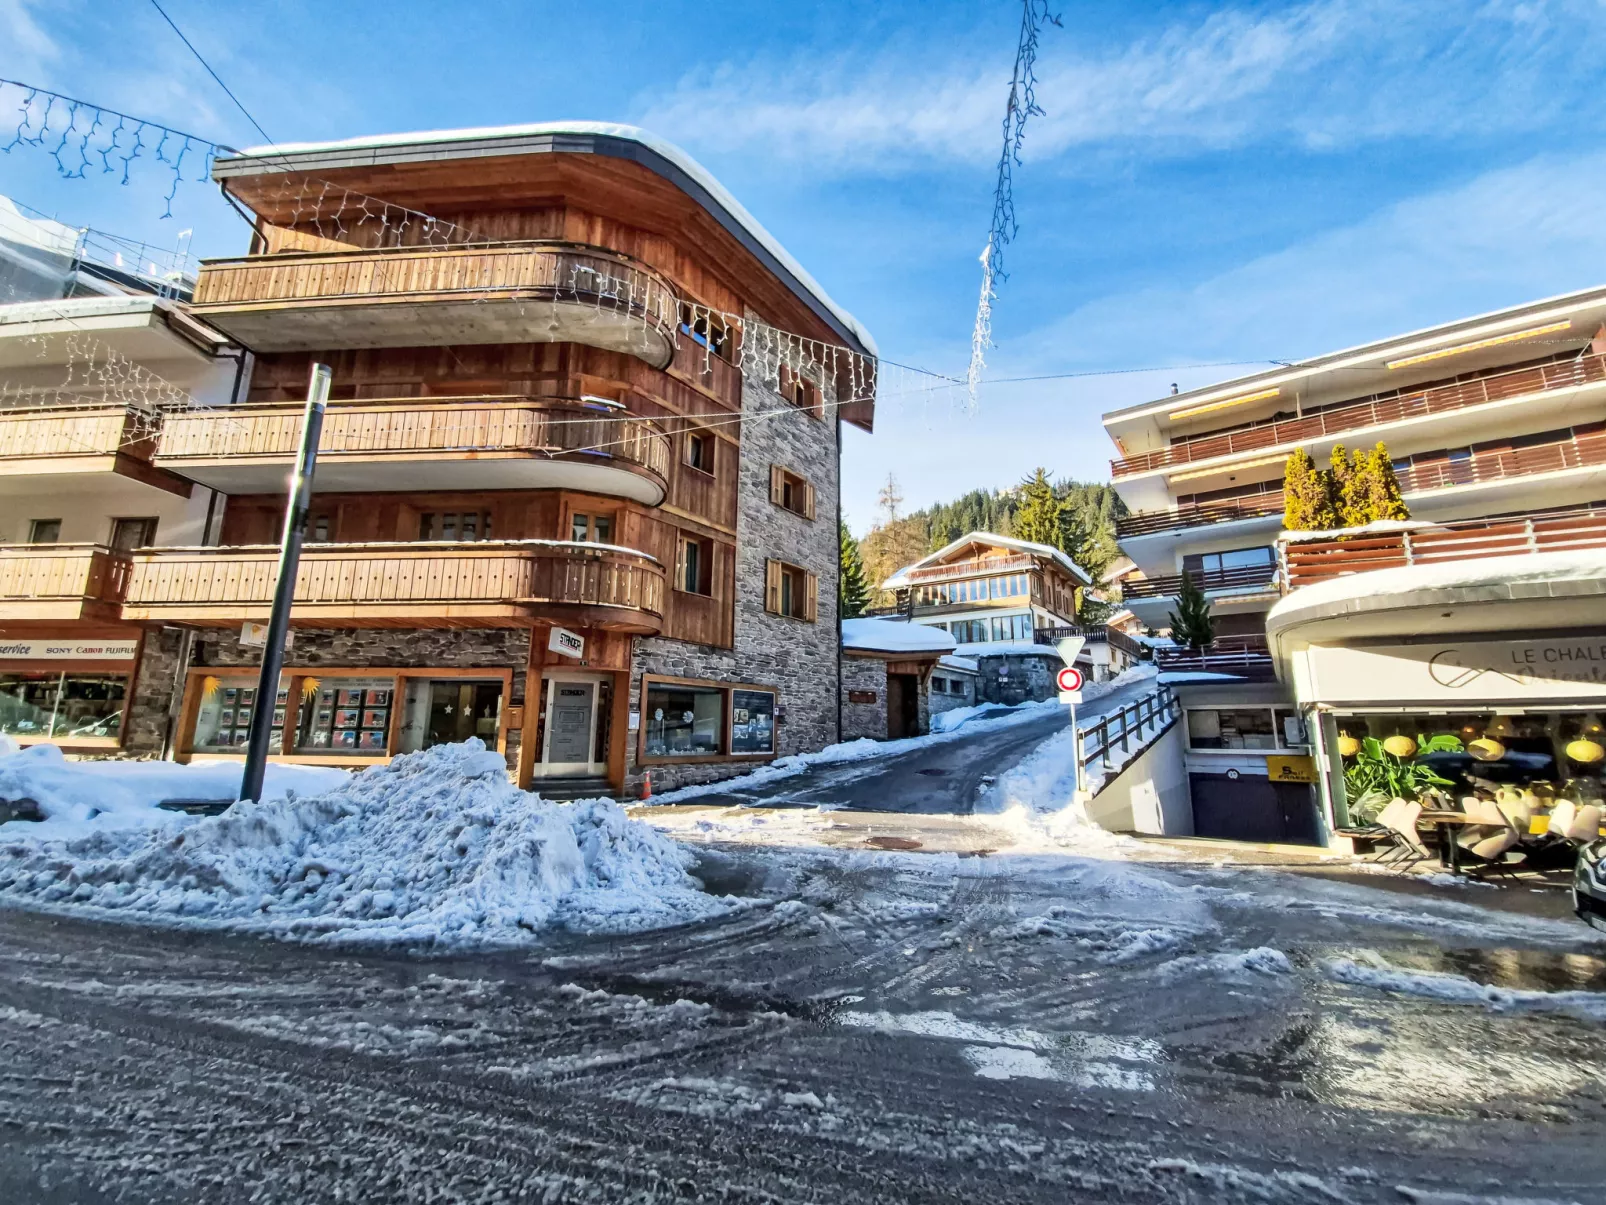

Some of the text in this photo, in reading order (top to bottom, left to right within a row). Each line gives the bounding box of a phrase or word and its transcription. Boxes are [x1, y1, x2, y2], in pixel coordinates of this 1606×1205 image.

[0, 643, 31, 655] service
[76, 646, 103, 654] Canon
[1511, 648, 1536, 664] LE
